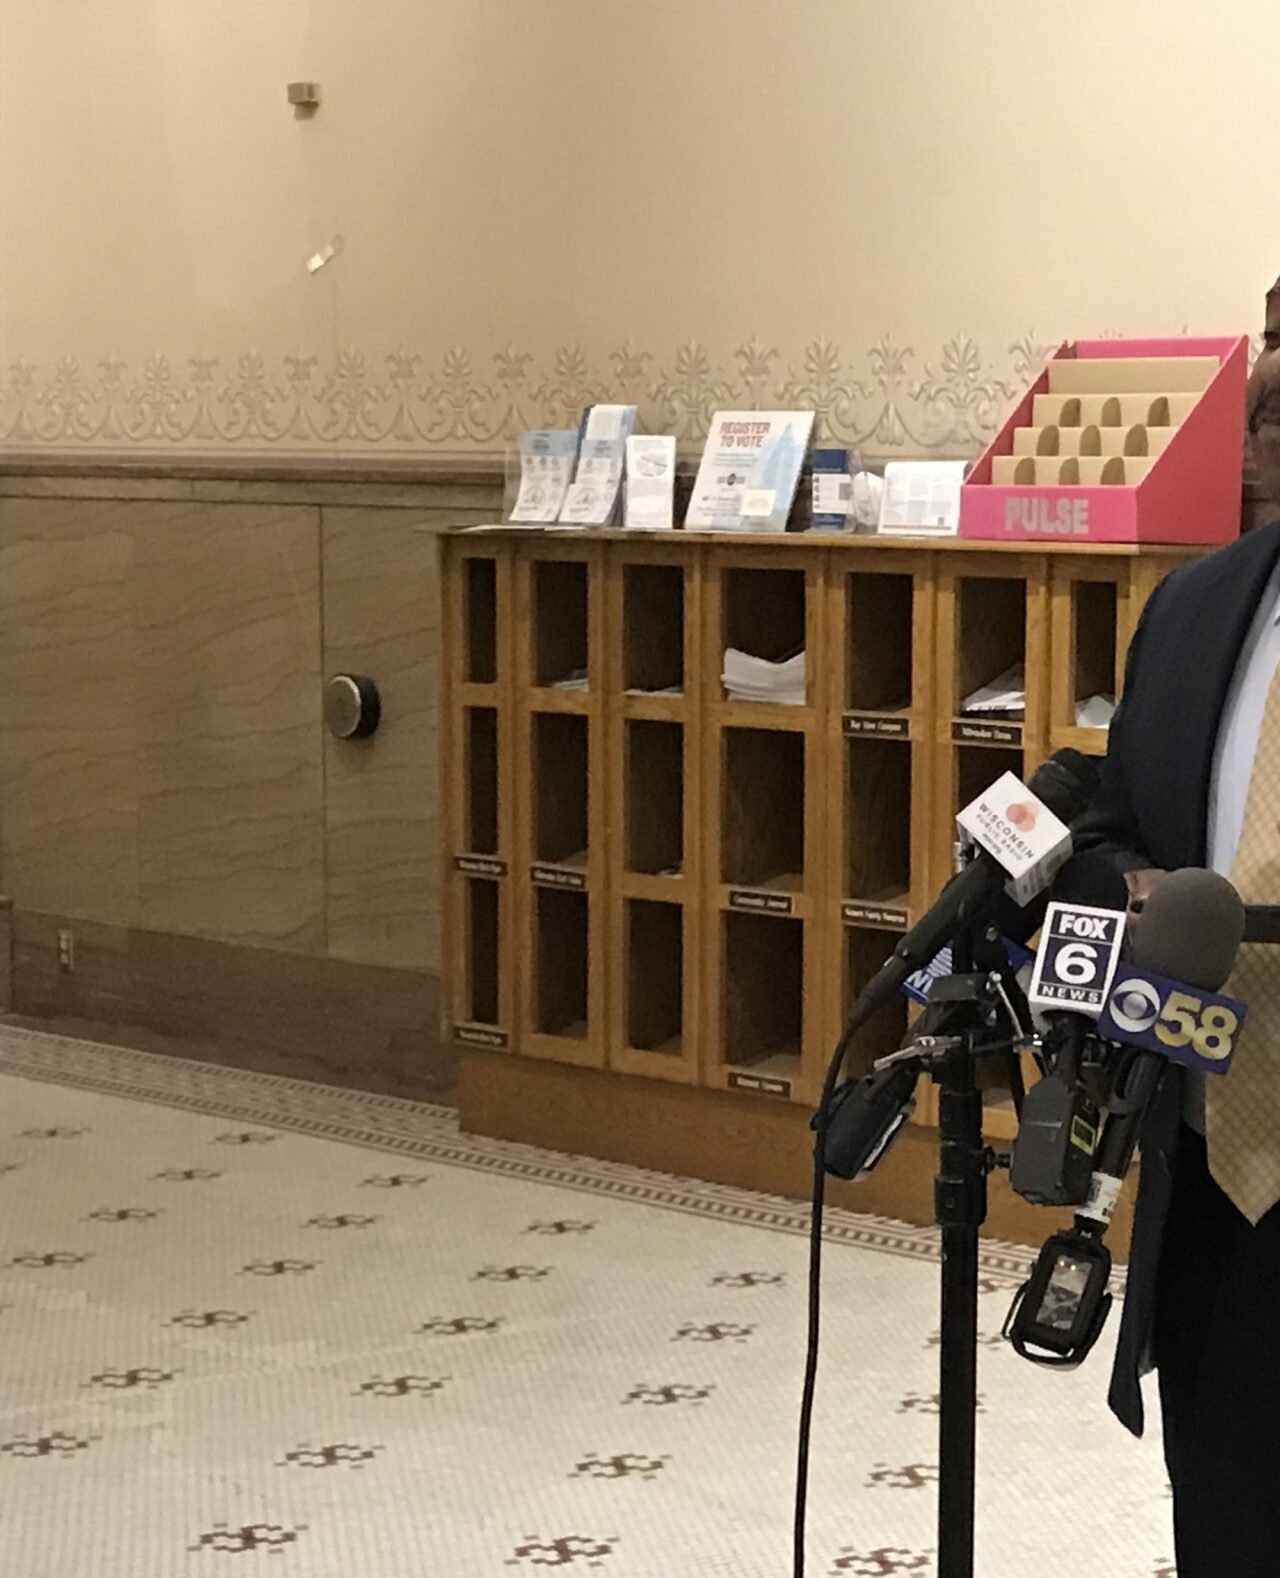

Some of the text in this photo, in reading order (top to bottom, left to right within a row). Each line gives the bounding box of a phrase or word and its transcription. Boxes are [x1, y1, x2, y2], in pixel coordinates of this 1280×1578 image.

[720, 421, 771, 434] REGISTER
[721, 435, 764, 448] TO VOTE
[1004, 496, 1089, 535] PULSE
[979, 802, 1036, 859] WISCONSIN
[1058, 913, 1110, 941] FOX
[1054, 942, 1099, 985] 6
[1041, 986, 1100, 1004] NEWS
[1153, 990, 1239, 1061] 58
